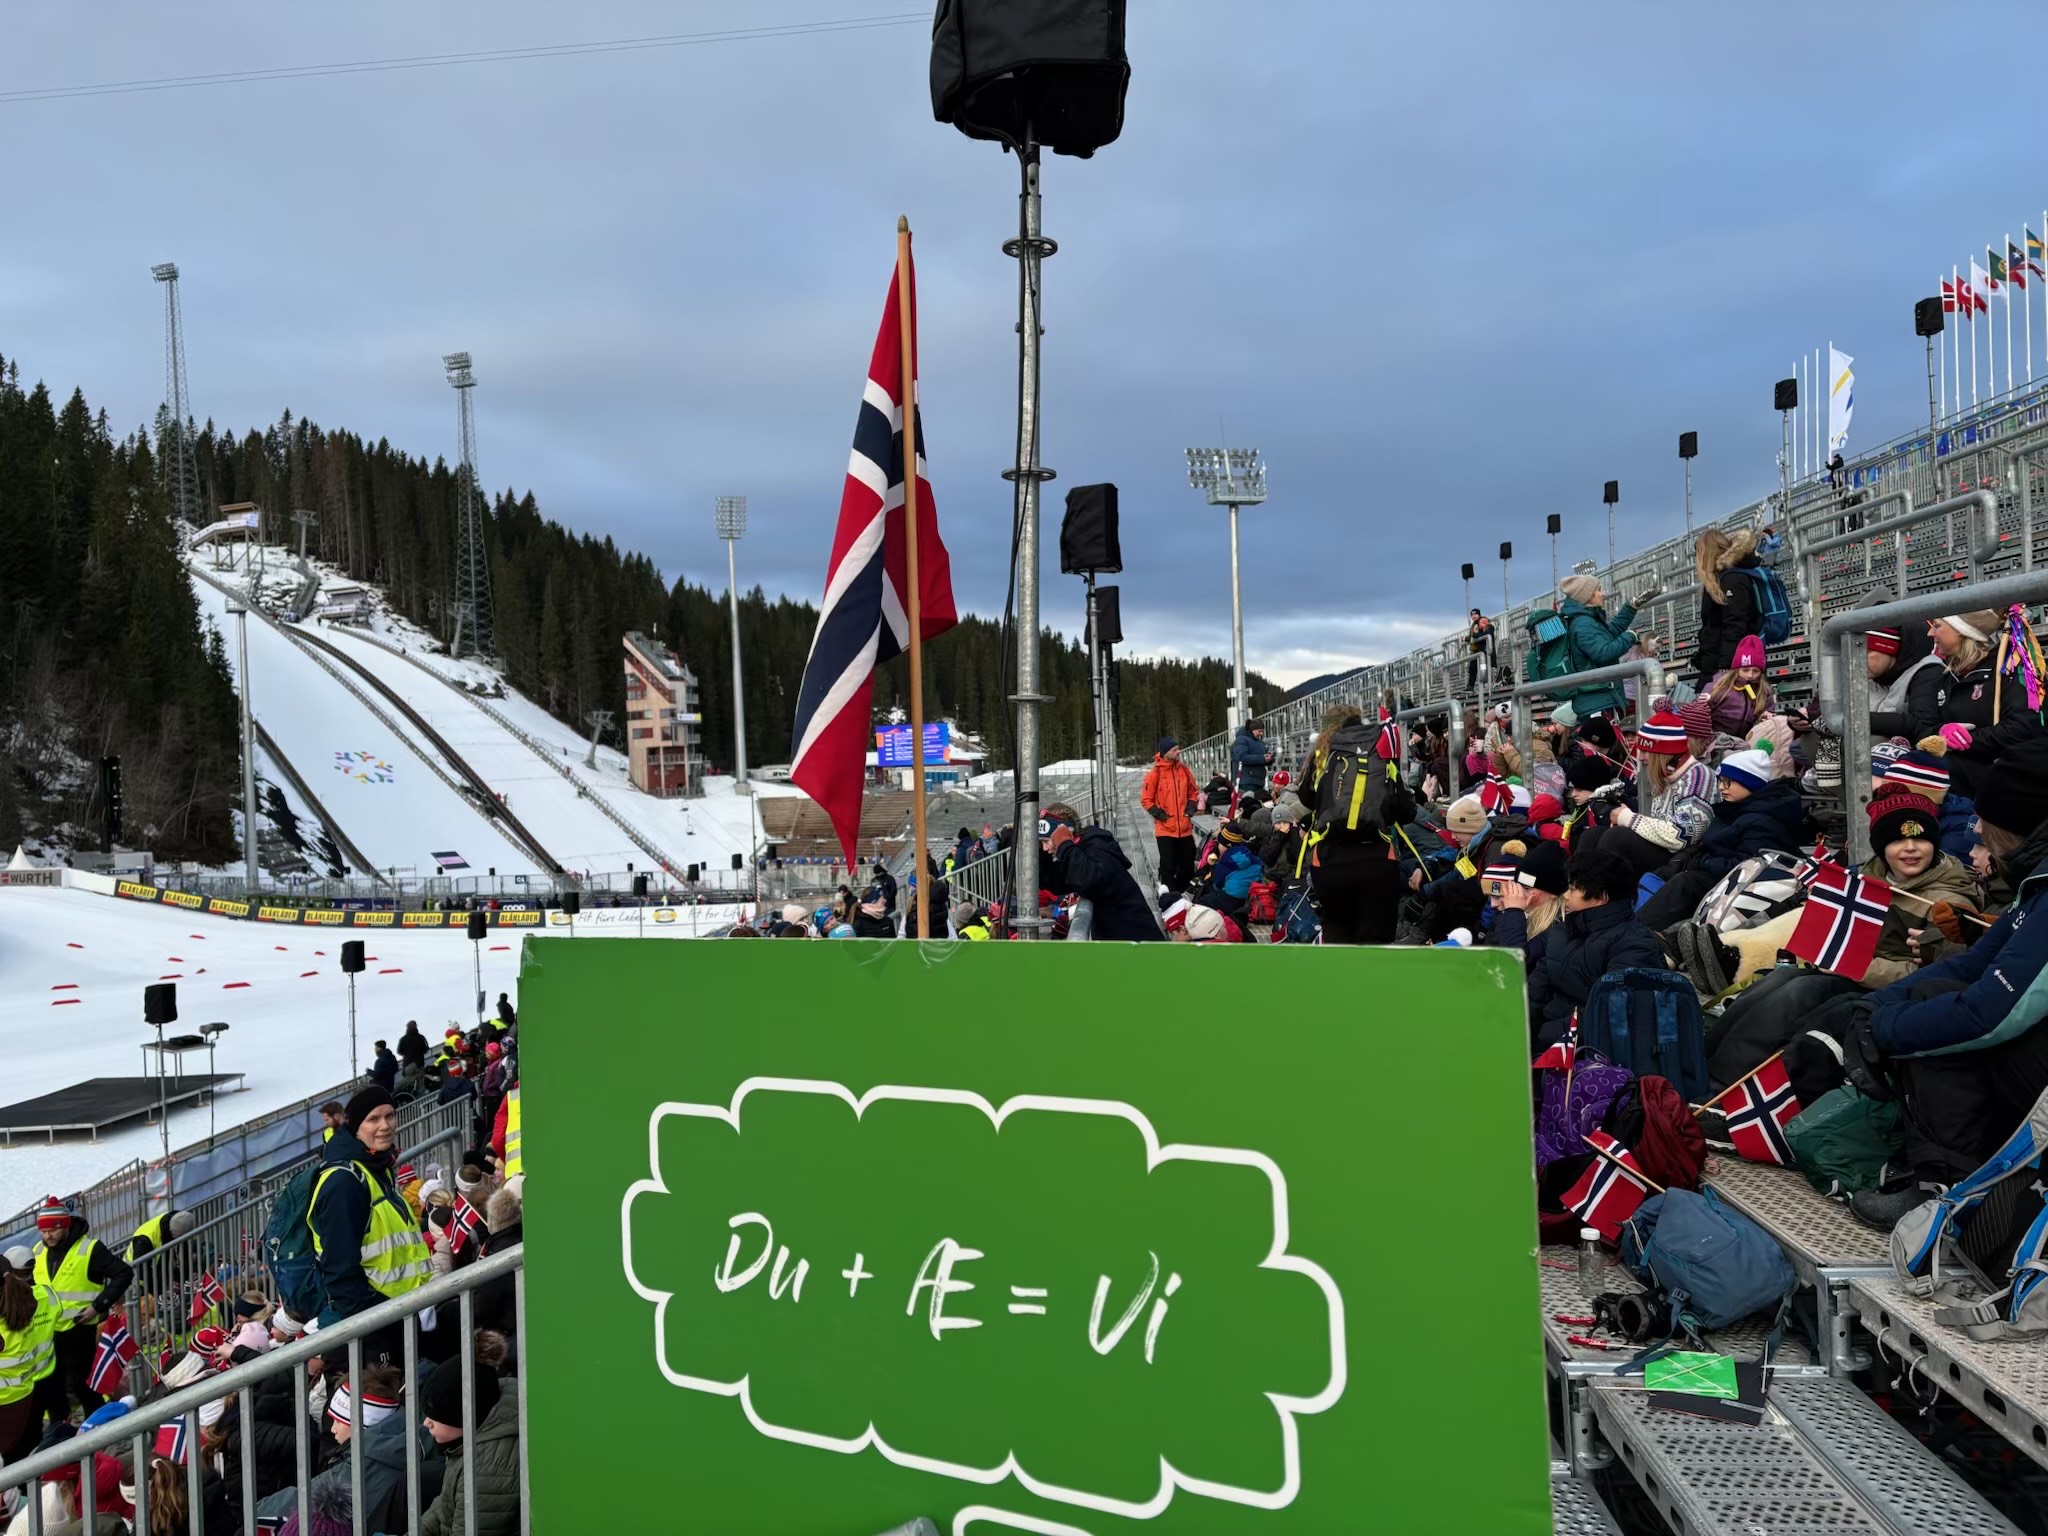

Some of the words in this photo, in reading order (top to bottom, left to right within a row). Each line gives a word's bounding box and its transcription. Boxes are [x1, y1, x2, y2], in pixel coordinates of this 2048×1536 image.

[715, 1212, 809, 1303] Du
[842, 1253, 873, 1297] +
[906, 1238, 984, 1341] Æ
[1008, 1286, 1047, 1315] =
[1089, 1252, 1182, 1364] Vi
